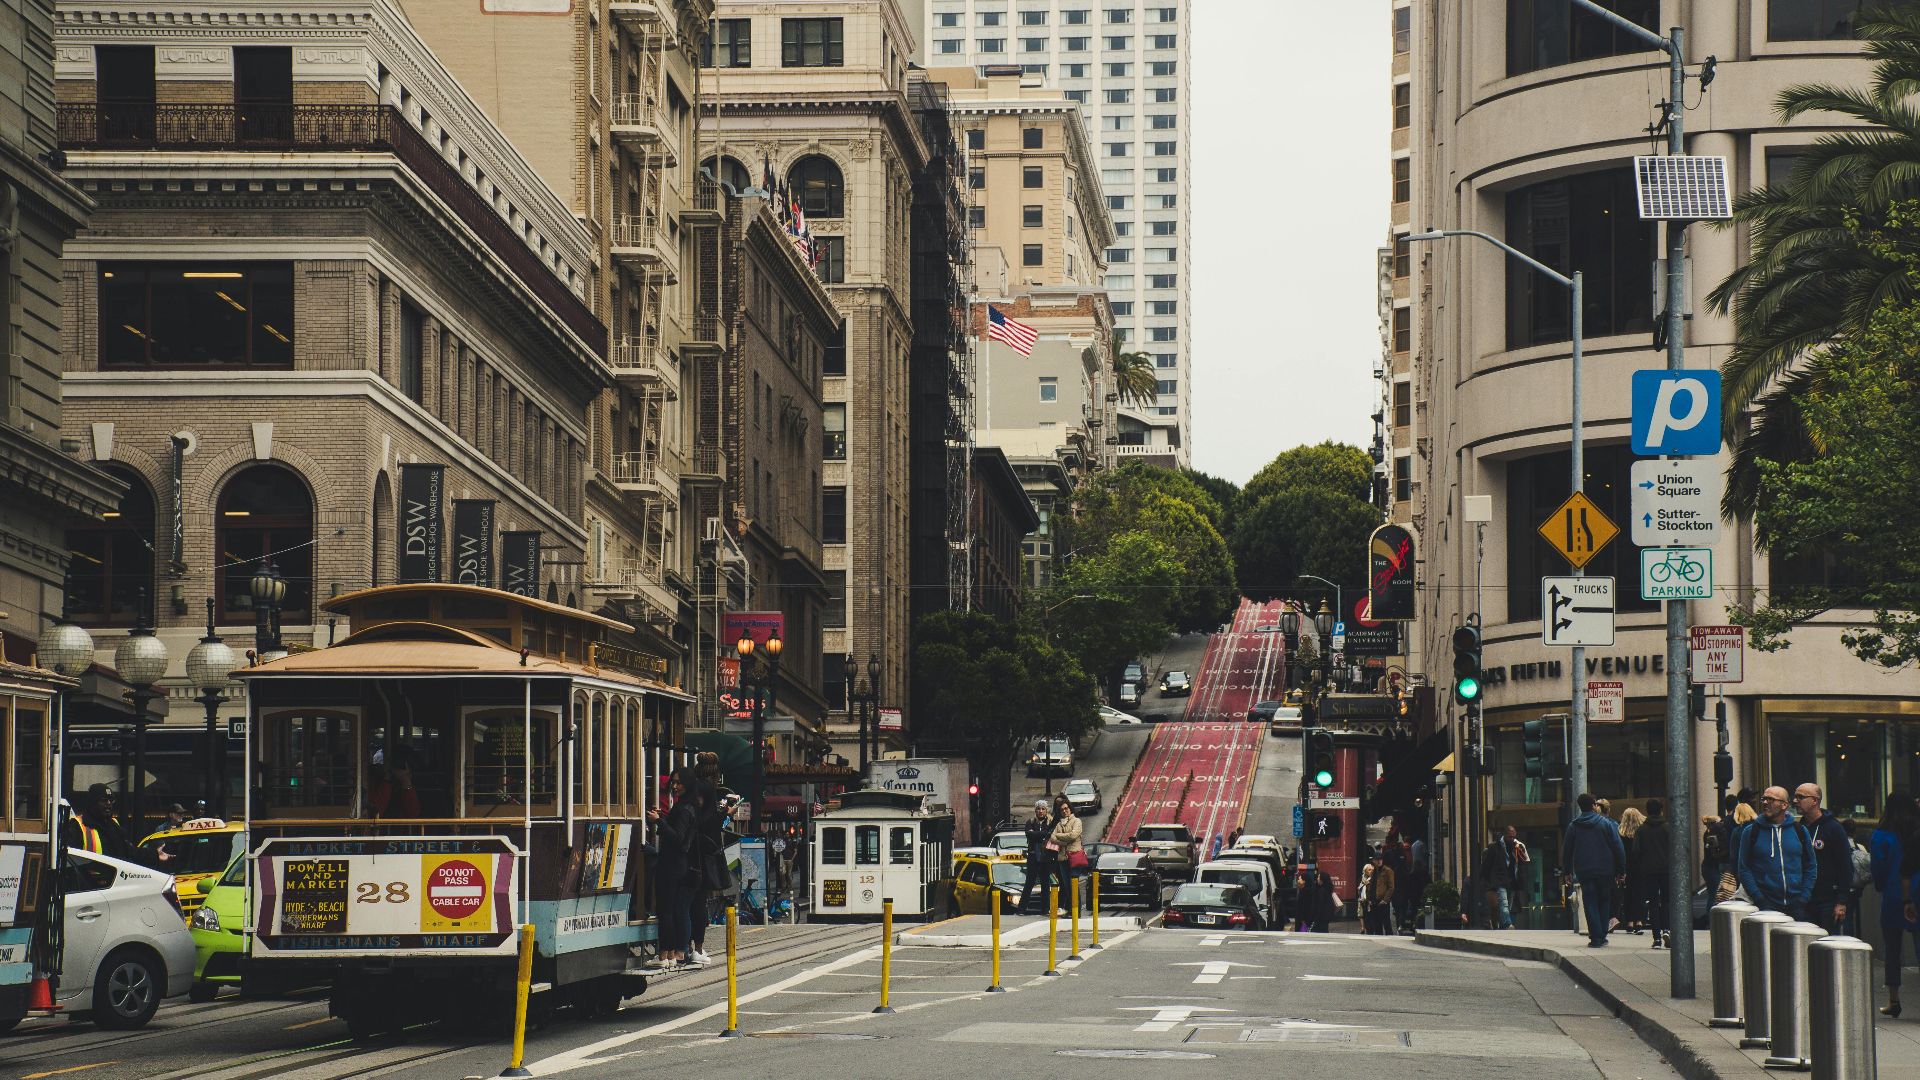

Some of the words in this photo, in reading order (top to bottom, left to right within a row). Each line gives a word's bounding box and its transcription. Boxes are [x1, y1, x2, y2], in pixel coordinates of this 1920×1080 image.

[1657, 474, 1693, 485] Union
[429, 470, 439, 520] WAREHOUSE
[1657, 486, 1701, 498] Square
[1657, 508, 1701, 519] Sutter-
[407, 500, 427, 556] DSW
[1657, 520, 1713, 531] Stockton
[428, 521, 437, 542] SHOE
[480, 506, 490, 557] WAREHOUSE
[528, 537, 536, 582] WAREHOUSE
[480, 557, 488, 576] SHOE
[508, 563, 526, 596] SW
[1574, 585, 1608, 594] TRUCKS
[1651, 586, 1704, 596] PARKING
[1694, 627, 1738, 635] TOW-AWAY
[1692, 637, 1706, 650] NO
[1707, 637, 1741, 649] STOPPING
[1707, 652, 1727, 662] ANY
[1510, 660, 1561, 681] FIFTH
[1585, 655, 1665, 676] VENUE
[1705, 663, 1729, 673] TIME
[1588, 689, 1598, 698] NO
[1598, 690, 1622, 698] STOPPING
[883, 780, 934, 792] Corona
[787, 806, 798, 814] 80
[188, 821, 216, 829] TAXI
[289, 842, 366, 854] MARKET
[386, 841, 463, 853] STREET
[288, 863, 347, 873] POWELL
[439, 869, 456, 877] DO
[456, 868, 475, 877] NOT
[302, 872, 332, 880] AND
[444, 876, 469, 885] PASS
[286, 880, 347, 890] MARKET
[356, 881, 410, 904] 28
[285, 902, 306, 912] HYDE
[318, 902, 345, 911] BEACH
[432, 898, 461, 907] CABLE
[462, 898, 480, 906] CAR
[301, 921, 327, 929] WHARF
[278, 935, 401, 949] FISHERMANS
[422, 935, 488, 947] WHARF
